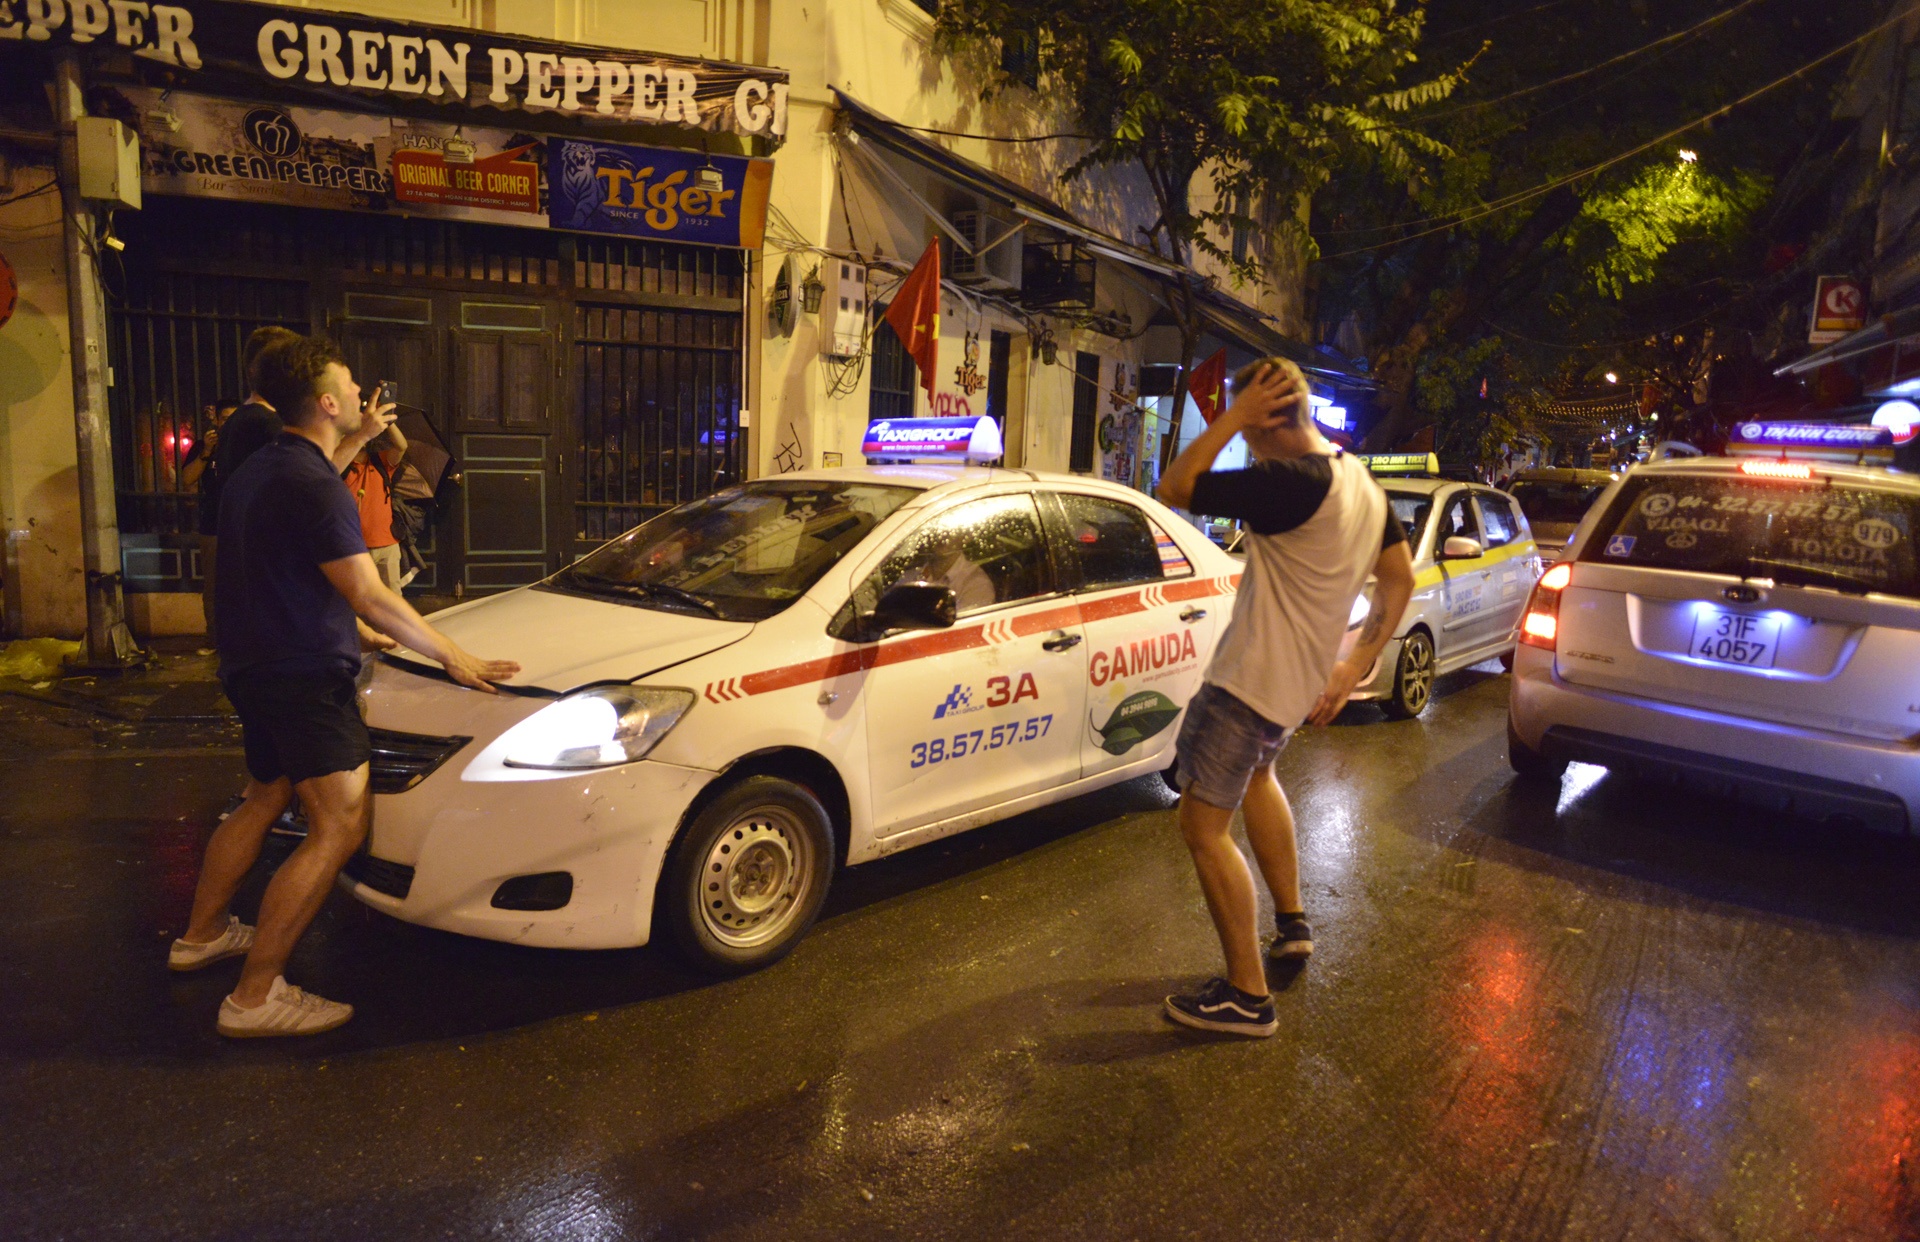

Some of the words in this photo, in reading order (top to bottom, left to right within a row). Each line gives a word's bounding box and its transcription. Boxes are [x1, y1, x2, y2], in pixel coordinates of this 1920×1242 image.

[257, 18, 471, 99] GREEN
[487, 47, 701, 125] PEPPER
[172, 149, 271, 181] GREEN
[275, 158, 386, 193] PEPPER
[201, 176, 226, 191] Bar
[399, 163, 452, 188] ORIGINAL
[455, 169, 483, 191] BEER
[487, 172, 531, 196] CORNER
[445, 193, 463, 201] HOAN
[480, 197, 505, 205] DISTRICT
[596, 164, 735, 231] Tiger
[609, 208, 639, 221] SINCE
[685, 217, 710, 227] 1932
[954, 364, 987, 397] Tiger
[876, 427, 974, 442] TAXIGROUP
[1764, 426, 1824, 440] THANH
[1370, 455, 1390, 465] SAO
[1407, 454, 1427, 464] TAXI
[1858, 523, 1893, 543] 979
[1790, 536, 1888, 564] TOYOTA
[1716, 614, 1757, 640] 31F
[1089, 629, 1197, 688] GAMUDA
[1699, 638, 1766, 665] 4057
[986, 672, 1040, 708] 3A
[962, 704, 985, 714] GROUP
[910, 713, 1054, 770] 38.57.57.57
